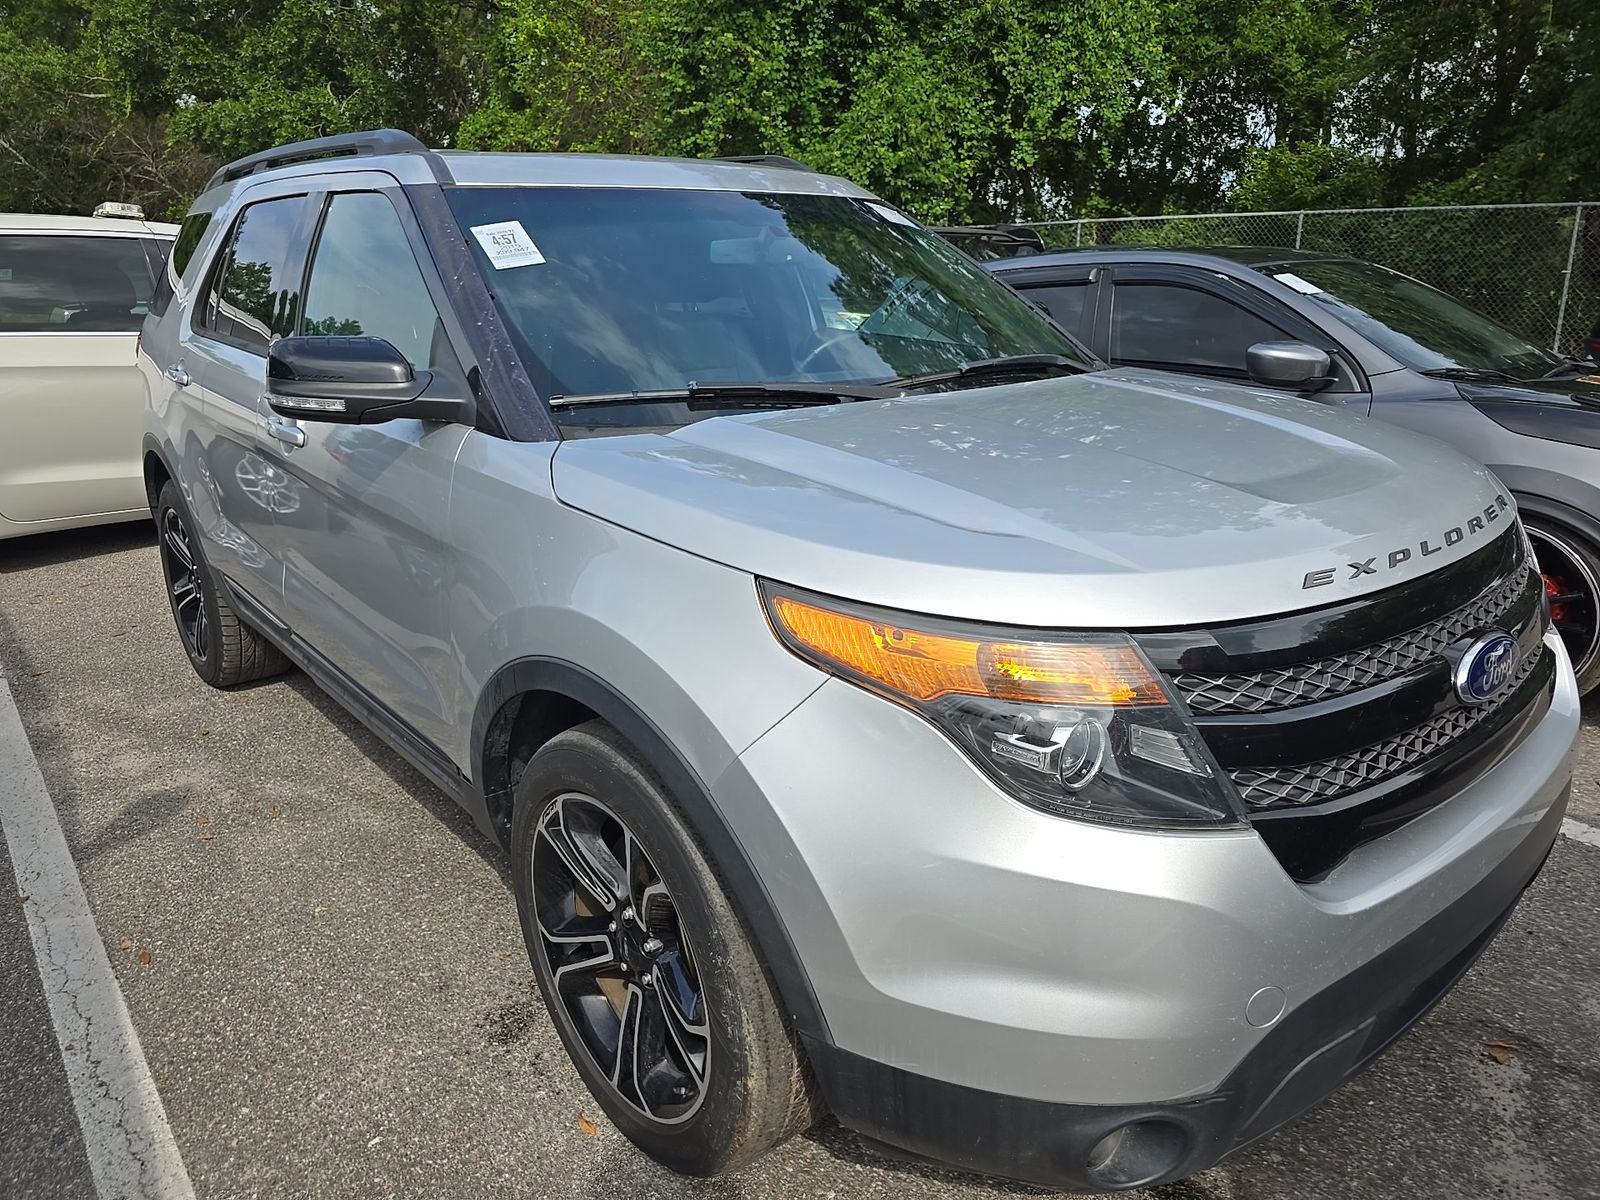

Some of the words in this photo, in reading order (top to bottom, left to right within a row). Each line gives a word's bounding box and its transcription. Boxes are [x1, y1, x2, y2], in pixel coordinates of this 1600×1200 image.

[492, 233, 517, 246] 4:57
[1301, 494, 1508, 589] EXPLORER
[1482, 640, 1512, 691] Ford
